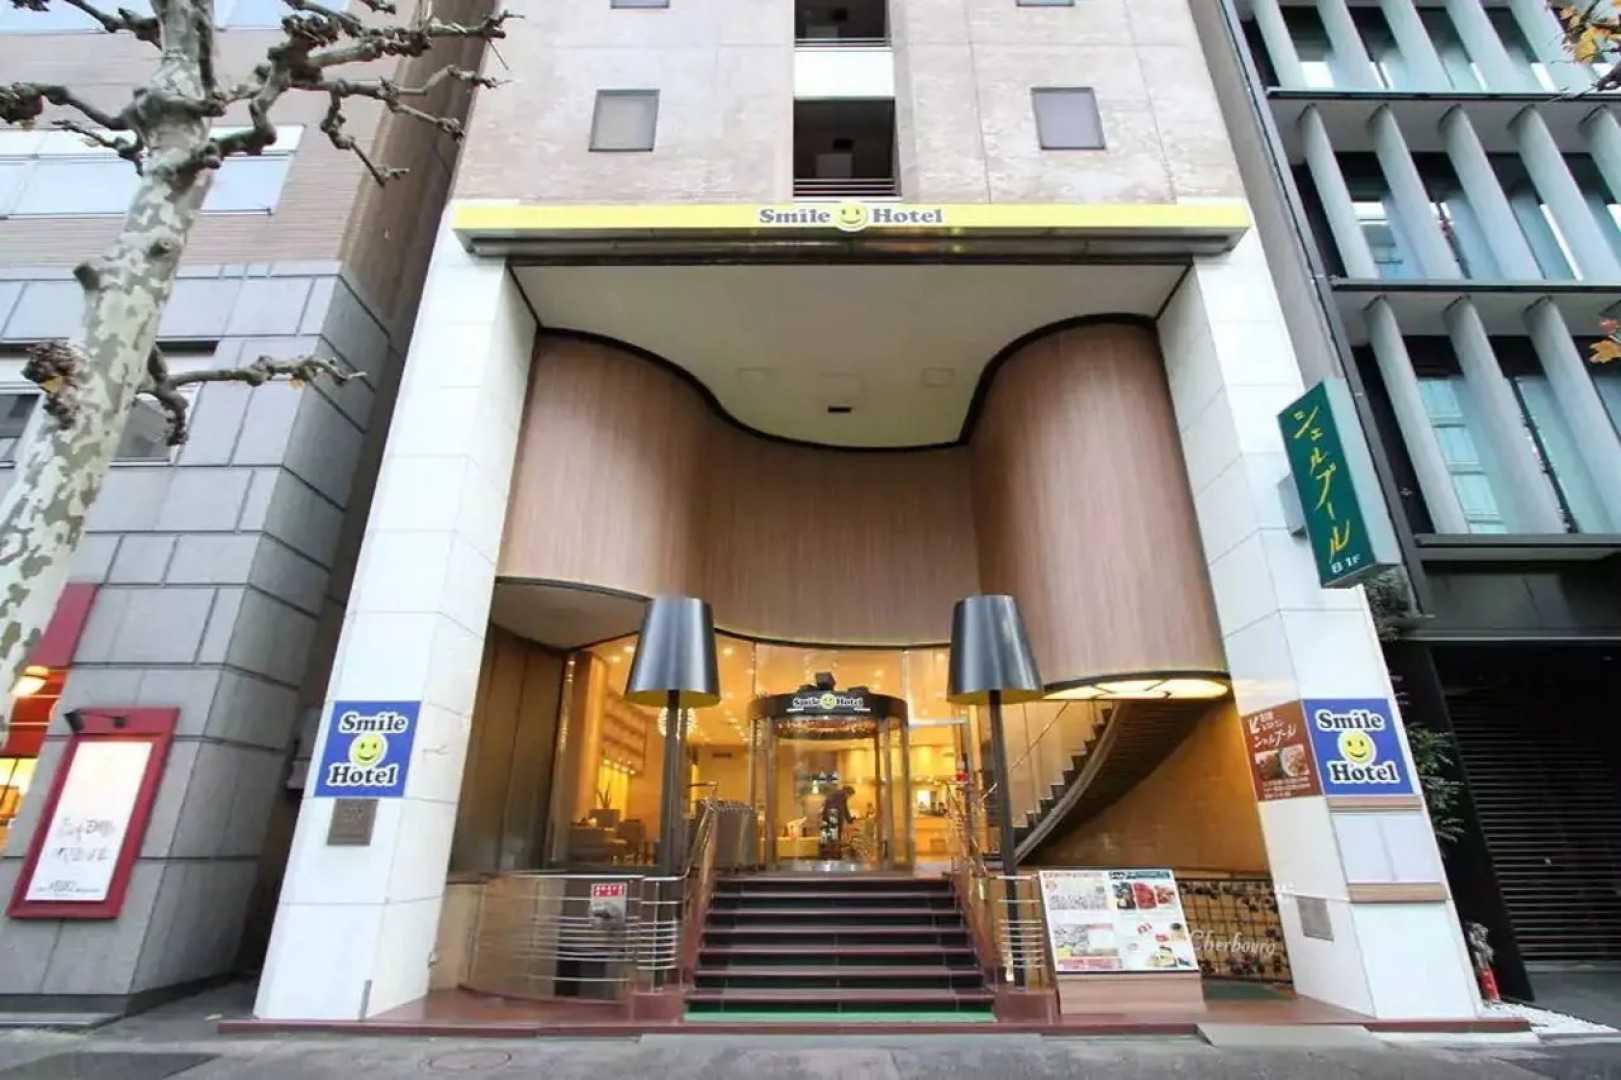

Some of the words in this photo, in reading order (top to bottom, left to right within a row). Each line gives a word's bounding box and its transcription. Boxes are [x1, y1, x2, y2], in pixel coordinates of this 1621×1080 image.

[759, 208, 831, 224] Smile
[873, 208, 943, 223] Hotel
[836, 696, 864, 708] Hotel
[340, 712, 407, 732] Smile
[1316, 711, 1384, 730] Smile
[328, 764, 398, 785] Hotel
[1329, 762, 1399, 782] Hotel
